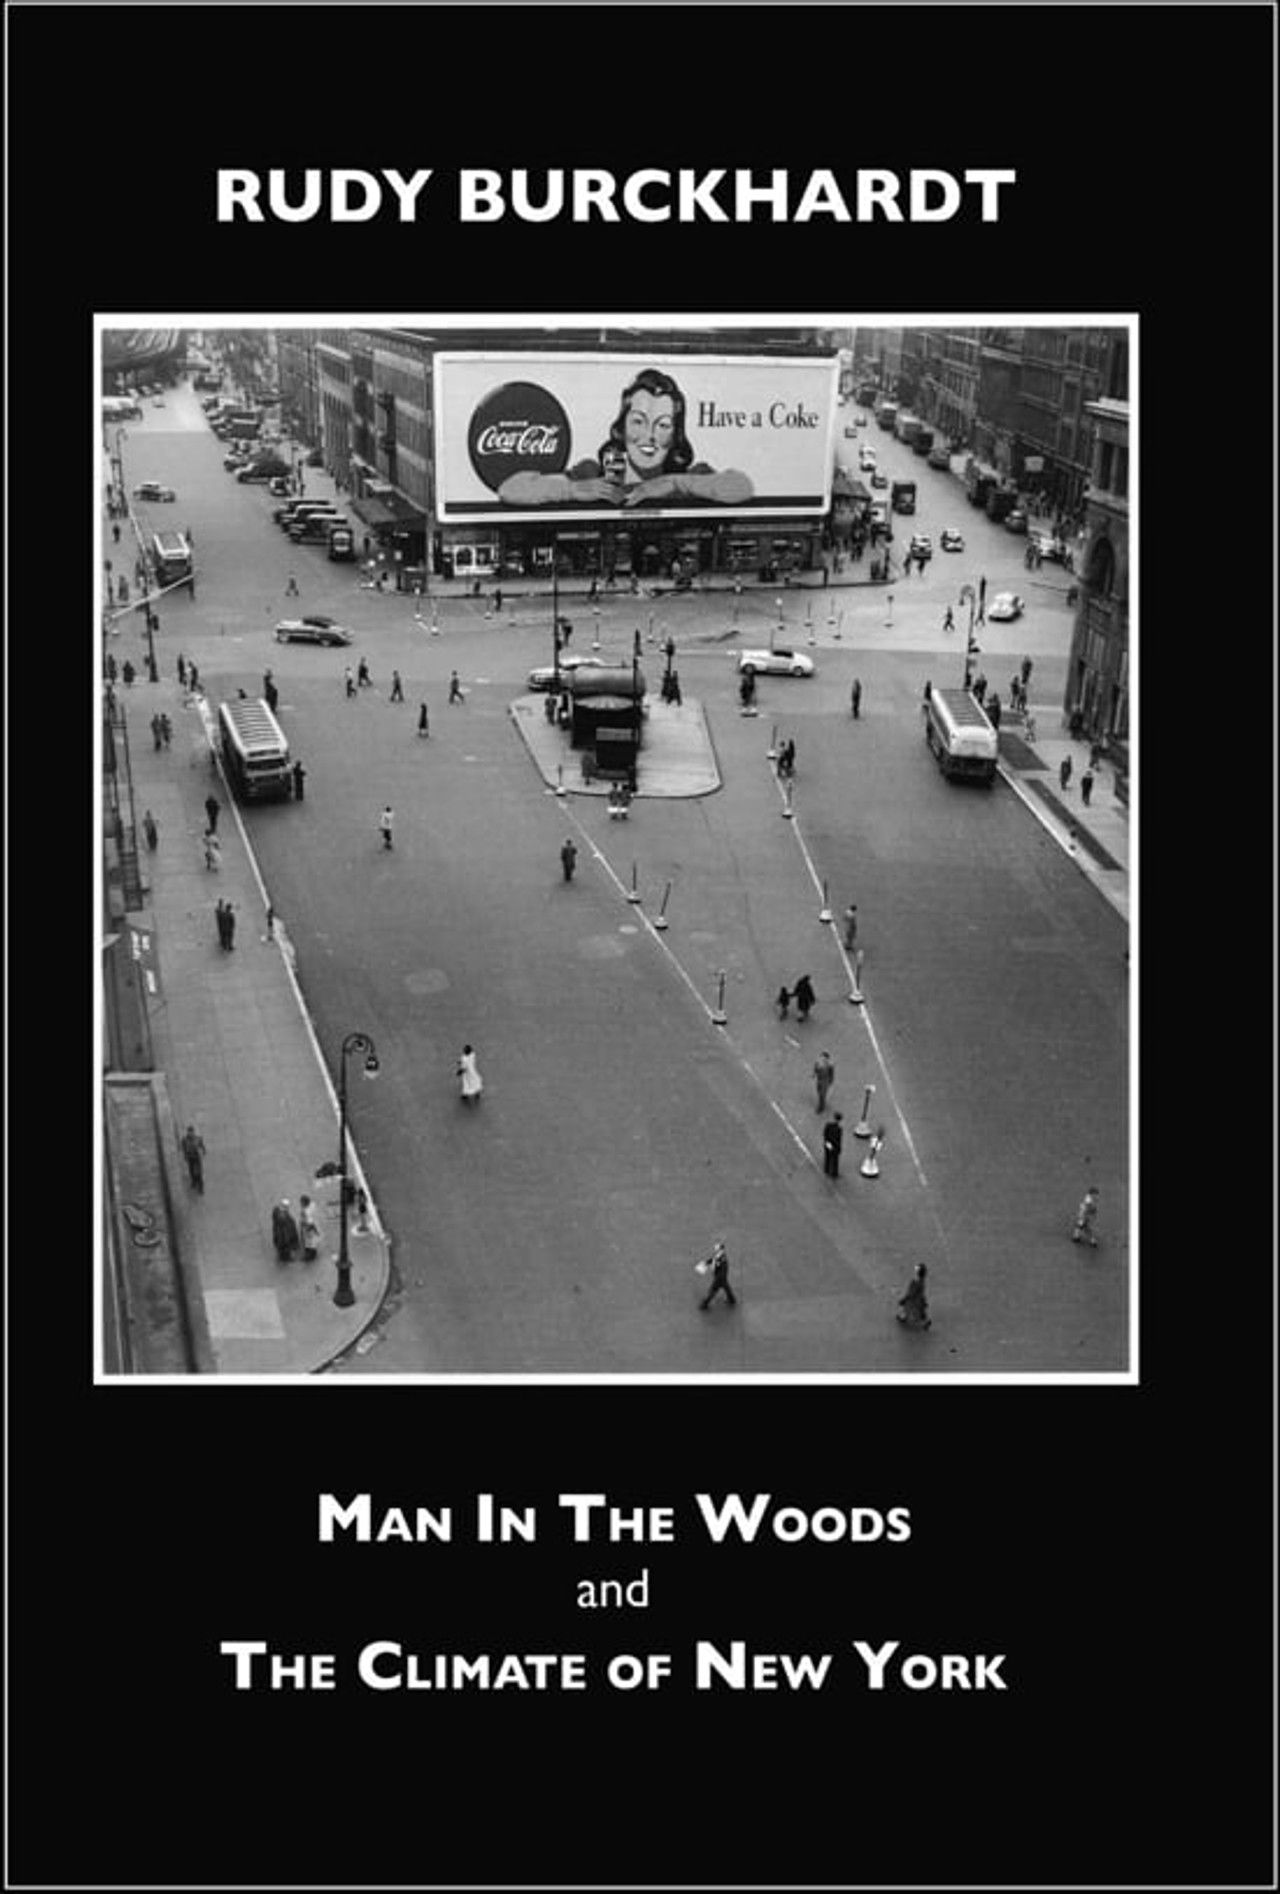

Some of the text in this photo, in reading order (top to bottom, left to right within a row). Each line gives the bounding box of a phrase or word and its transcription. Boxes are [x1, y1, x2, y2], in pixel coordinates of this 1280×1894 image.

[698, 400, 819, 429] Have a Coke
